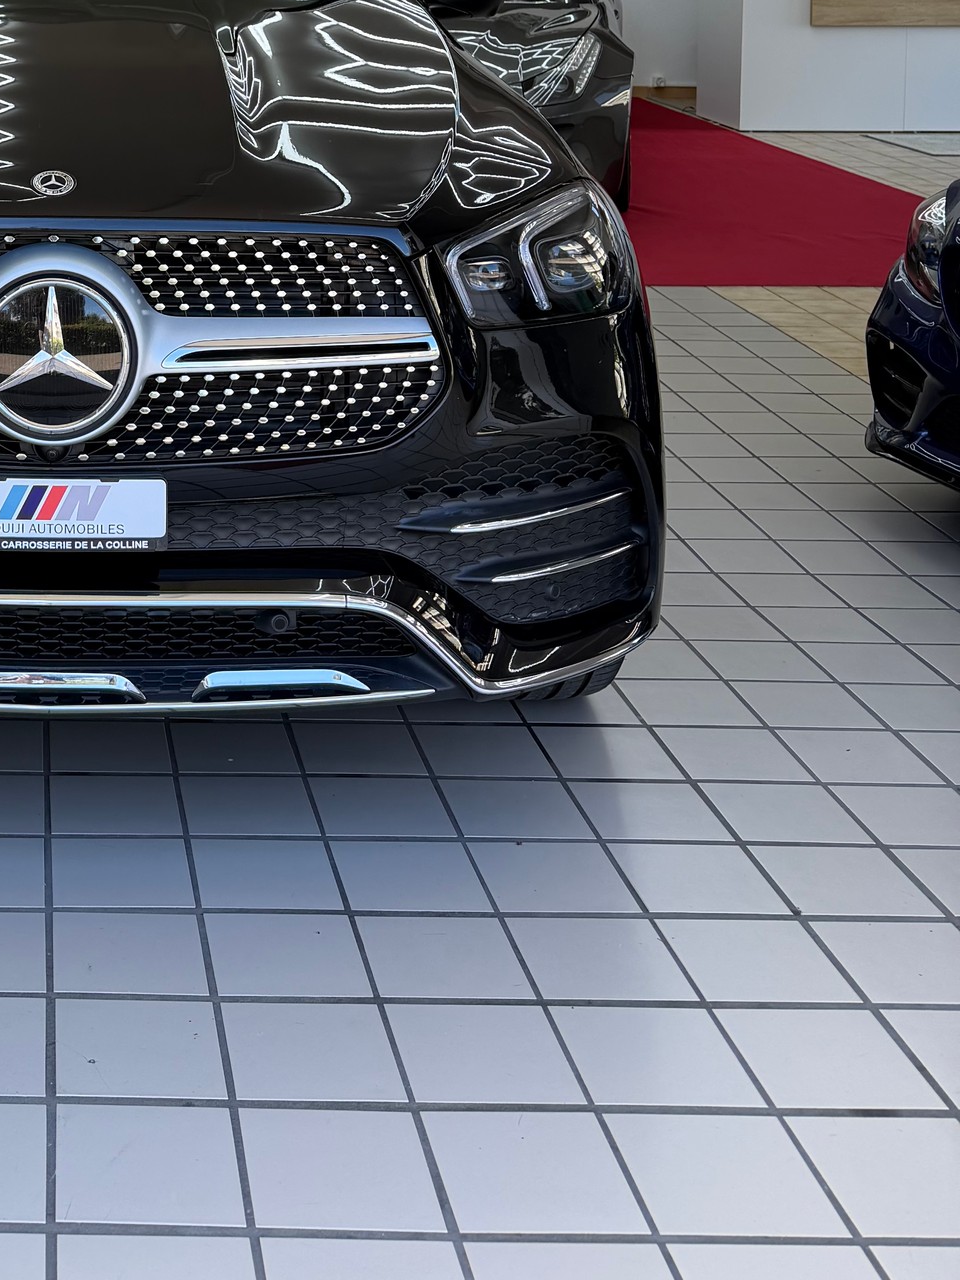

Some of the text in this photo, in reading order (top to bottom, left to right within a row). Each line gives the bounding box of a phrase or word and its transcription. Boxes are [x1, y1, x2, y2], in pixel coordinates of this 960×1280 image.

[28, 523, 125, 535] AUTOMOBILES
[1, 540, 72, 550] CARROSSERIE
[74, 540, 89, 549] DE
[90, 540, 104, 549] LA
[105, 540, 149, 549] COLLINE
